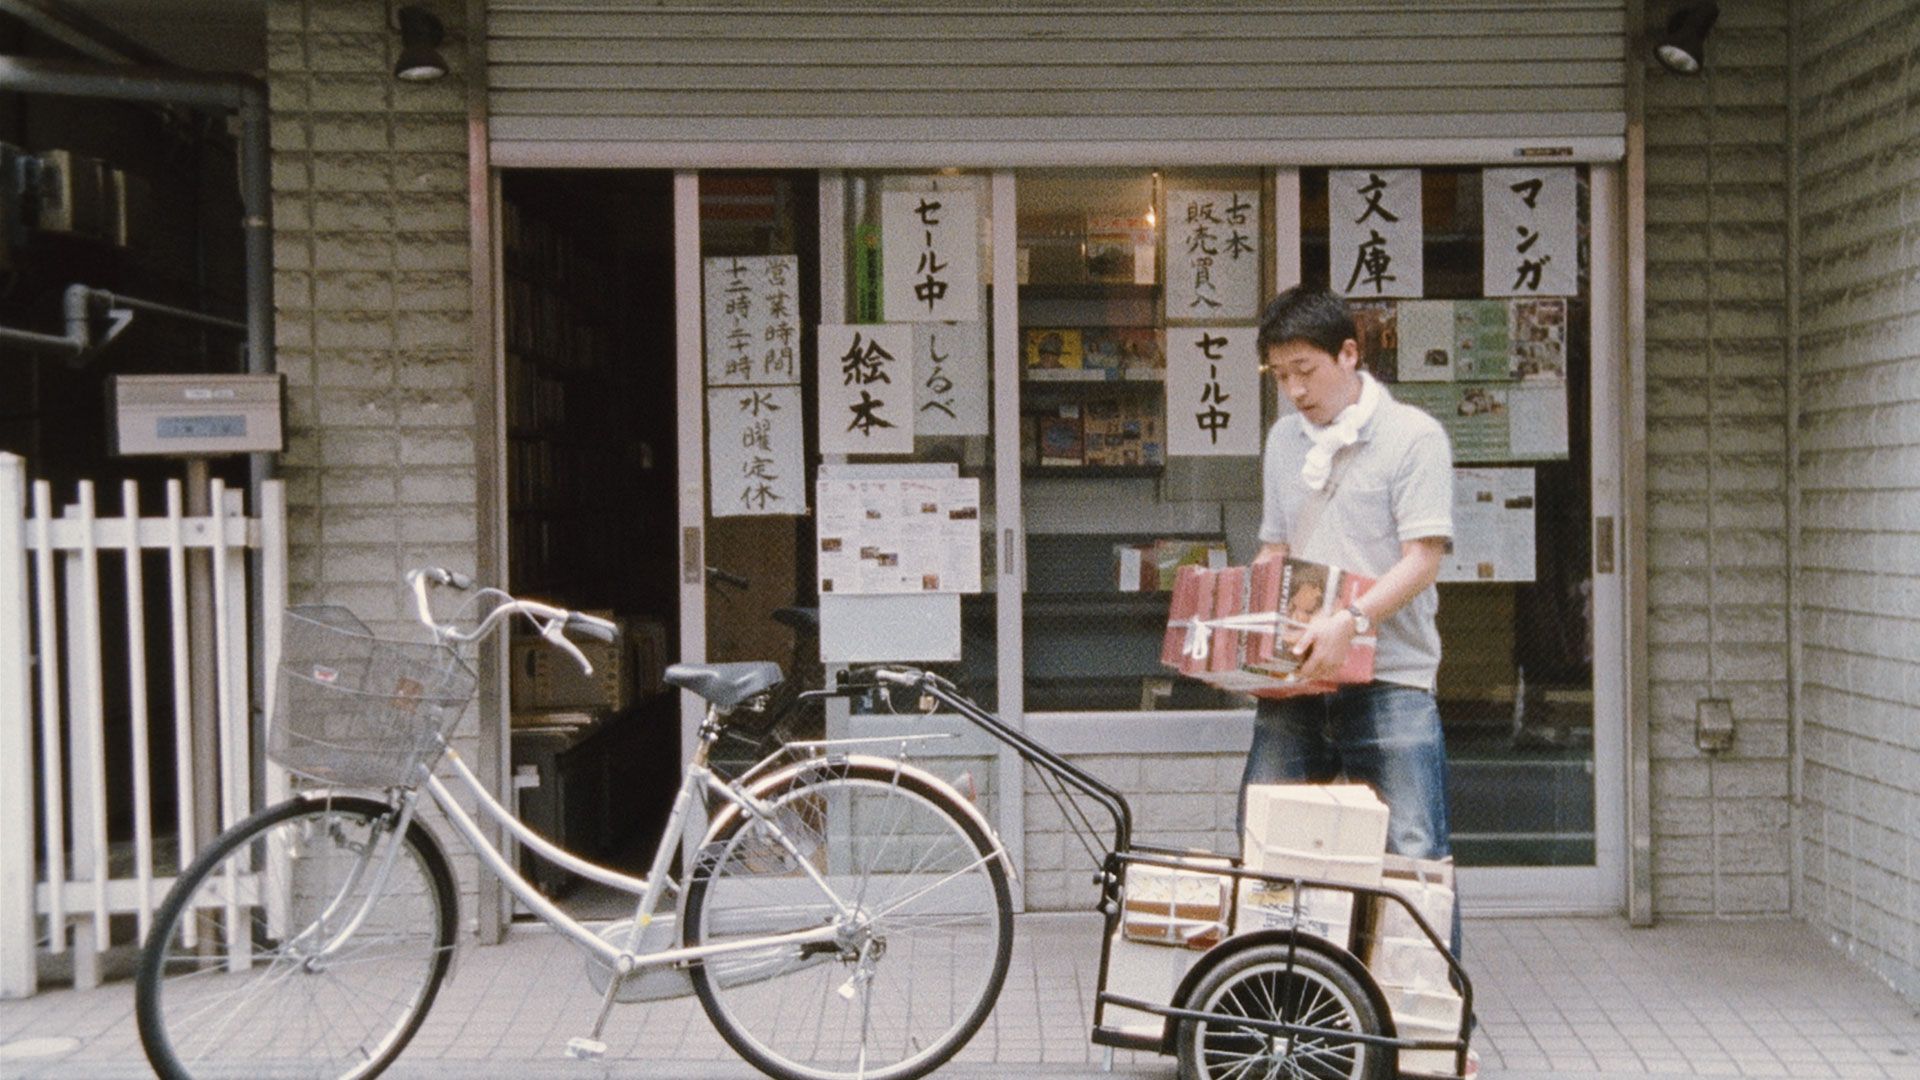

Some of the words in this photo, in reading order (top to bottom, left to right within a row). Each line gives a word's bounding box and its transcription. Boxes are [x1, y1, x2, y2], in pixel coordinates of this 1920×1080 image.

[914, 198, 949, 314] セール中
[1185, 201, 1222, 309] 販売買入
[1223, 192, 1255, 260] 古本
[1346, 173, 1398, 293] 文庫
[1510, 178, 1551, 291] マンガ
[765, 259, 796, 376] 営業時間
[841, 331, 898, 437] 絵本
[1195, 332, 1231, 445] セール中
[740, 390, 784, 510] 水曜定休
